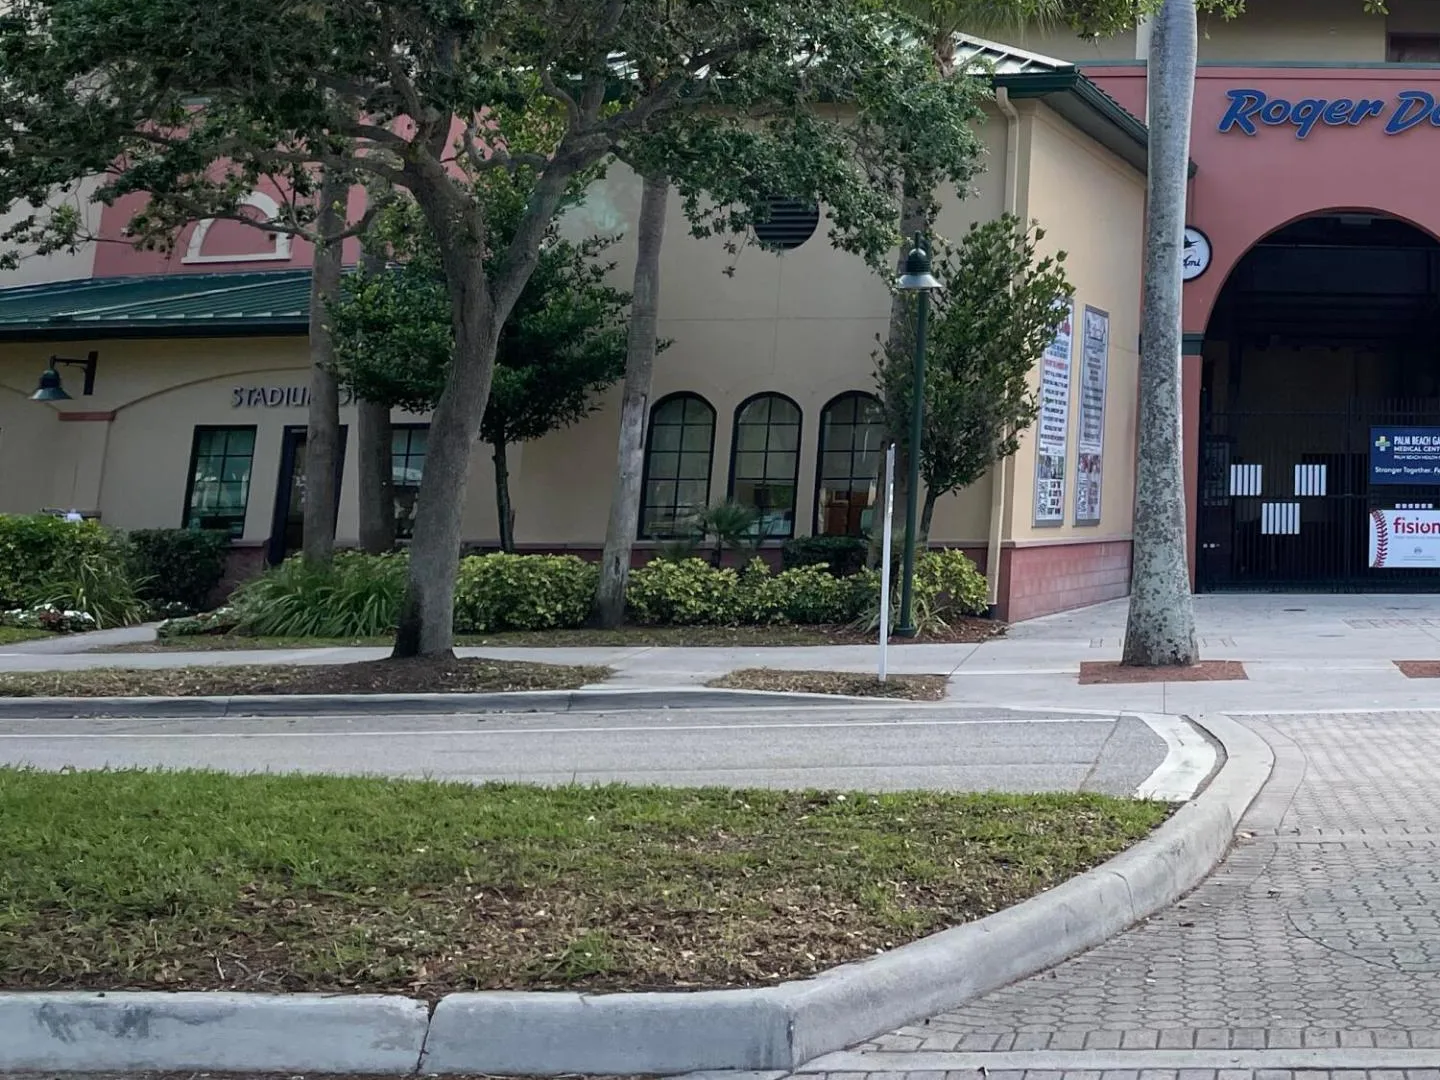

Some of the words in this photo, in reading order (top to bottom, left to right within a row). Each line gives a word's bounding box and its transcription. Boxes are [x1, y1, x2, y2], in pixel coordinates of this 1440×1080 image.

[1217, 88, 1385, 140] Roger
[1393, 435, 1411, 445] PALM
[1411, 435, 1431, 445] BEACH
[1375, 466, 1402, 475] Stronger
